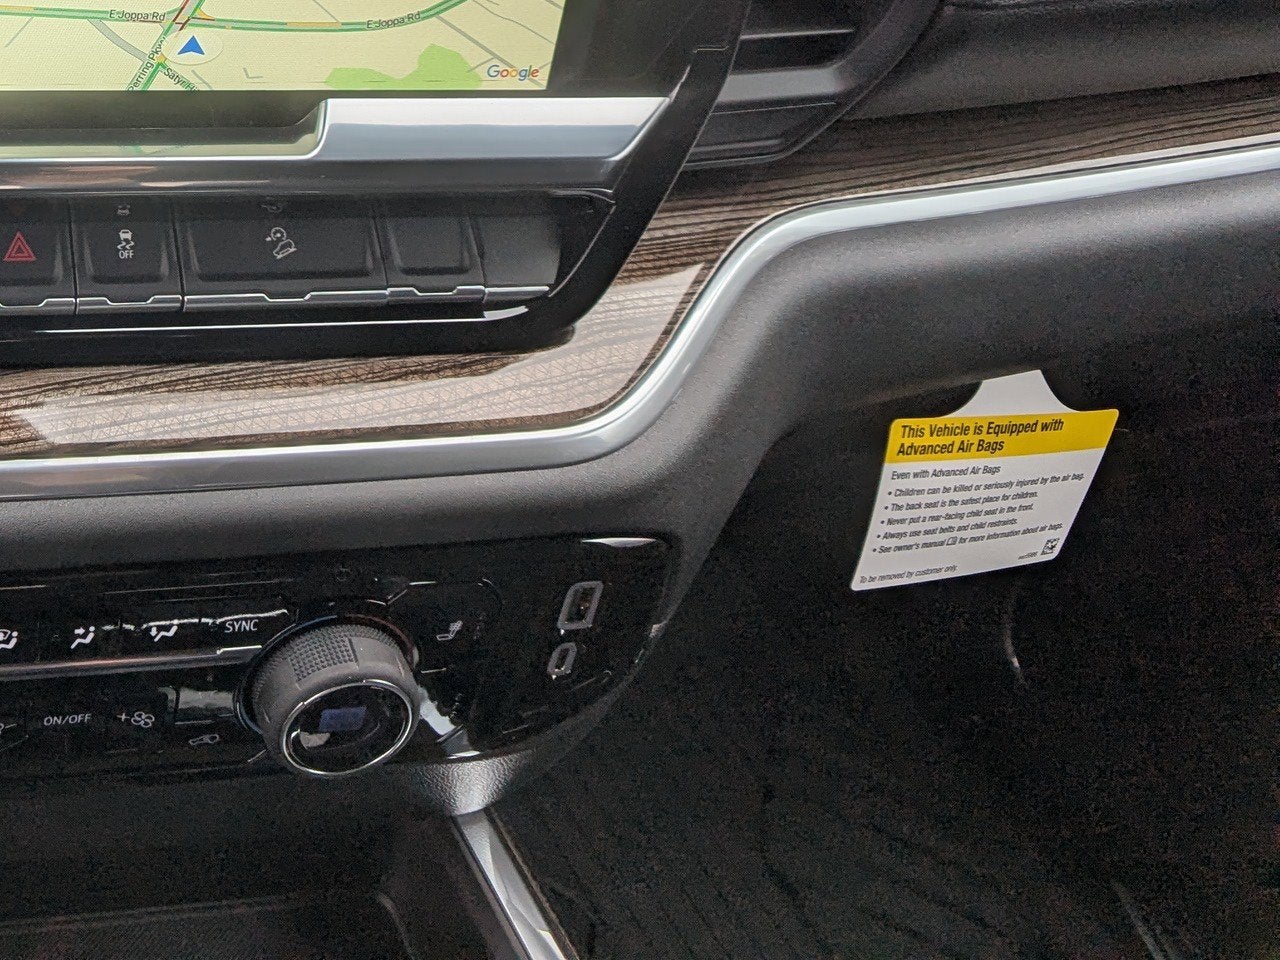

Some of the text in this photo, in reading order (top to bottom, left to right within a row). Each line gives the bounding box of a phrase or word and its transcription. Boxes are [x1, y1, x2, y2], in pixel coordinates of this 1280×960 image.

[109, 9, 166, 22] E Joppa Rd
[366, 10, 421, 29] E Joppa Rd
[486, 64, 540, 82] Google
[118, 250, 135, 259] OFF
[901, 418, 1065, 439] This Vehicle is Equipped with
[896, 439, 1005, 456] Advanced Air Bags
[891, 464, 1002, 481] Even with Advanced Air Bags
[893, 486, 926, 498] Children
[927, 486, 940, 495] can
[941, 485, 952, 494] be
[952, 483, 973, 493] killed
[973, 483, 982, 491] or
[983, 480, 1016, 491] seriously
[1015, 477, 1039, 488] injured
[1039, 476, 1050, 486] by
[1049, 474, 1061, 483] the
[1061, 473, 1071, 482] air
[859, 575, 868, 584] To
[868, 574, 876, 583] be
[878, 571, 906, 582] removed
[905, 570, 915, 580] by
[915, 565, 944, 577] customer
[224, 619, 259, 633] SYNC
[43, 713, 92, 726] ON/OFF
